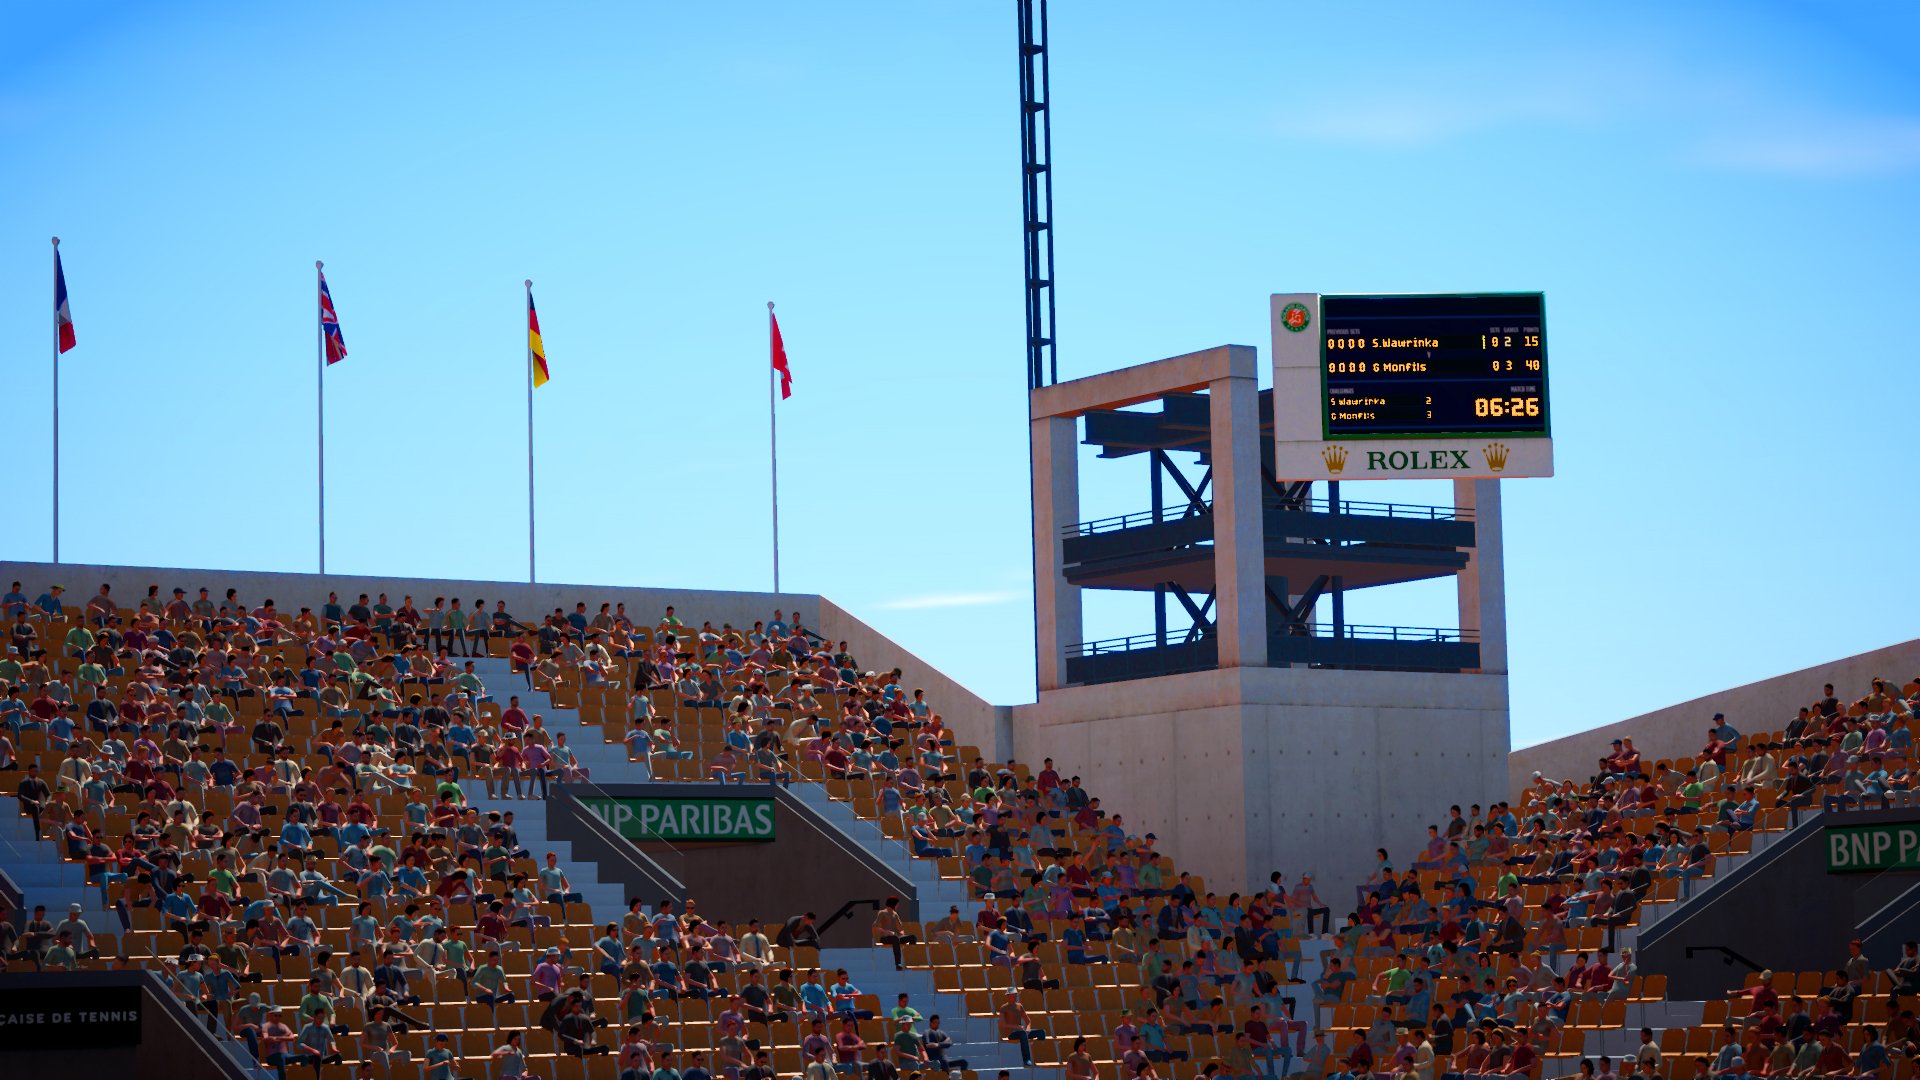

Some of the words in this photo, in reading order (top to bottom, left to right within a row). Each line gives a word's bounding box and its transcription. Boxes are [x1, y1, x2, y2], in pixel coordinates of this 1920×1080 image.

[1491, 336, 1499, 347] 0
[1504, 336, 1512, 347] 2
[1524, 335, 1539, 347] 15
[1492, 360, 1500, 372] 0
[1505, 360, 1513, 371] 3
[1525, 359, 1540, 371] 40
[1425, 397, 1432, 405] 2
[1475, 398, 1539, 417] 06:26
[1426, 411, 1432, 419] 3
[1366, 450, 1472, 470] ROLEX
[640, 804, 773, 835] PARIBAS
[1830, 831, 1892, 867] BNP
[1898, 829, 1920, 863] P
[52, 1012, 72, 1024] DE
[79, 1010, 137, 1023] TENNIS
